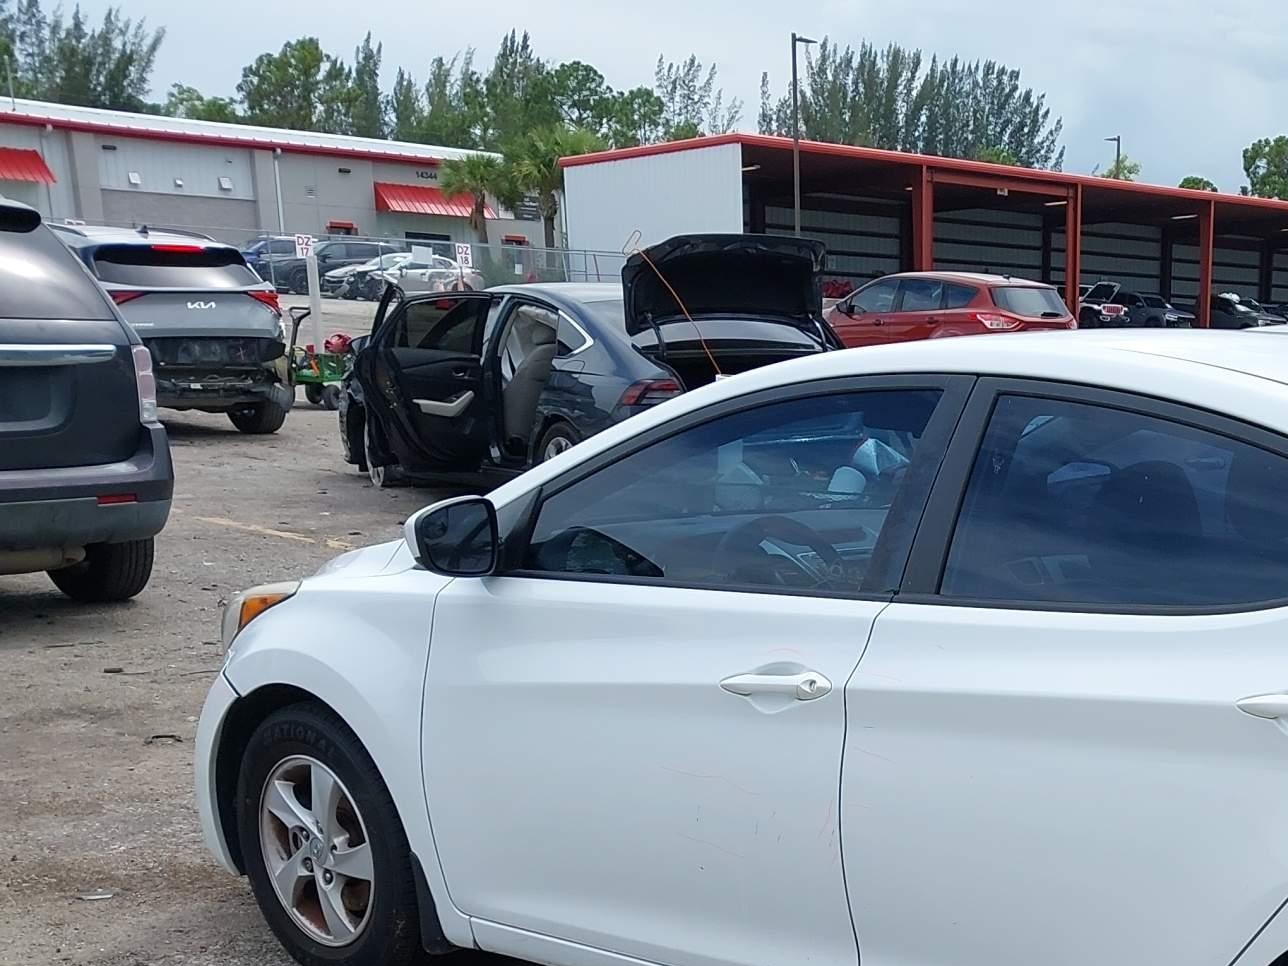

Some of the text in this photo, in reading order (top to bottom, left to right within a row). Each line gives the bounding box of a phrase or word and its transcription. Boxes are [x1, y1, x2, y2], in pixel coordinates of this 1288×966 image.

[416, 170, 438, 180] 14344
[297, 236, 311, 246] DZ
[301, 247, 309, 256] 17
[457, 245, 470, 255] DZ
[460, 256, 470, 265] 18
[187, 301, 217, 309] KIA
